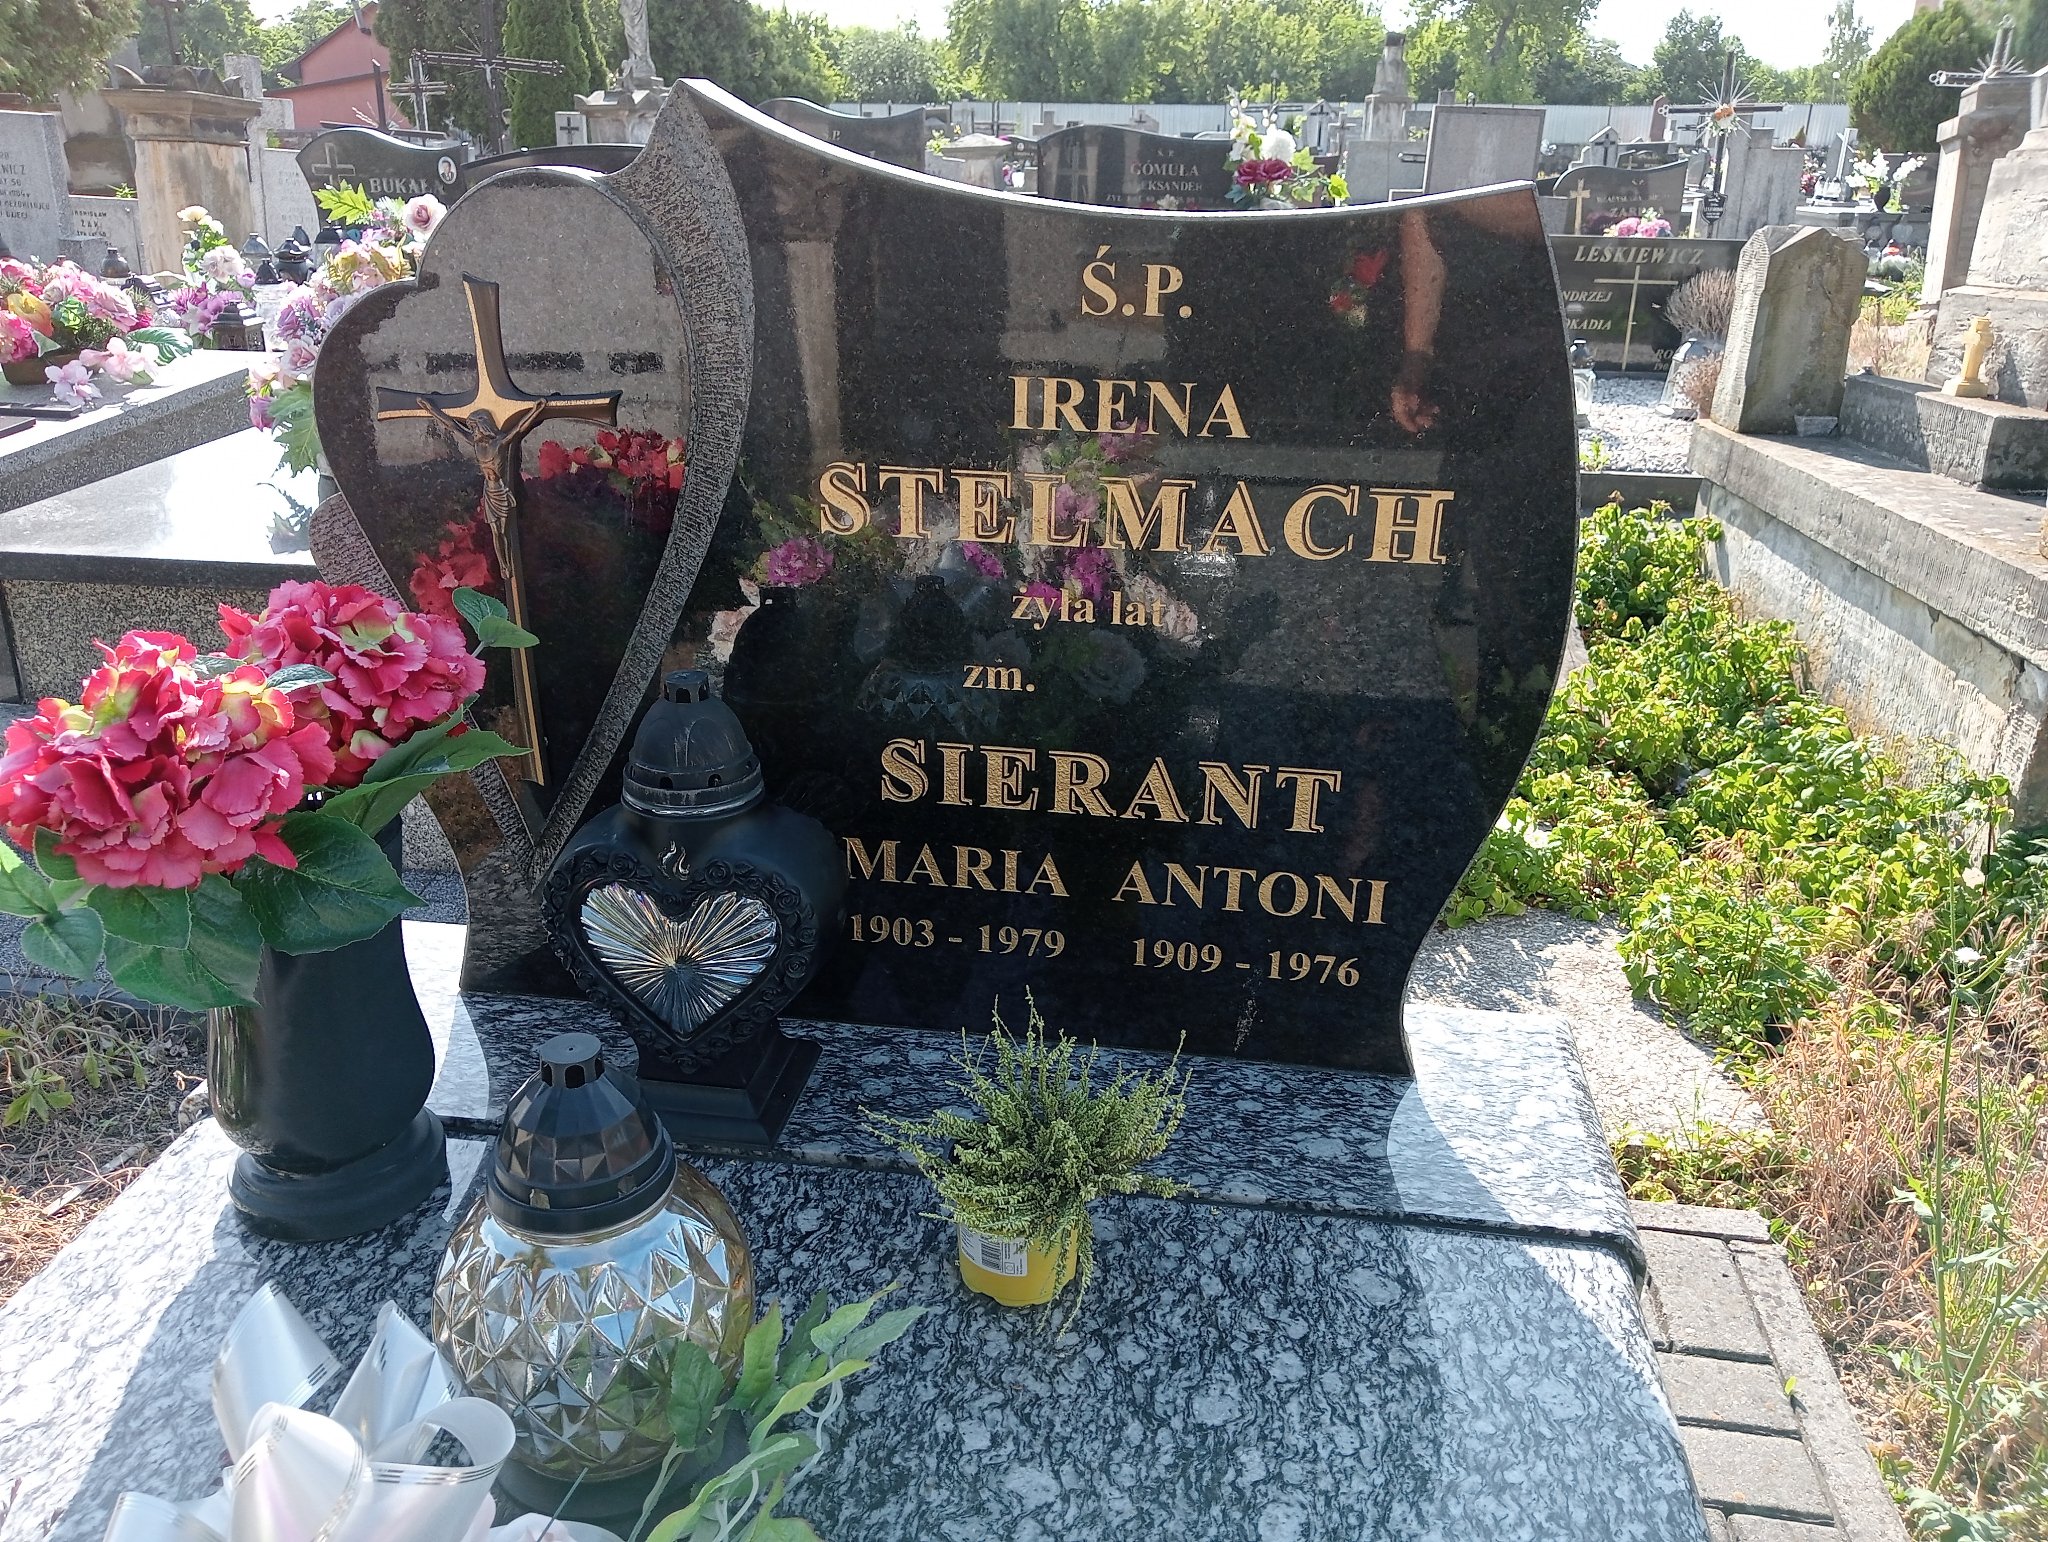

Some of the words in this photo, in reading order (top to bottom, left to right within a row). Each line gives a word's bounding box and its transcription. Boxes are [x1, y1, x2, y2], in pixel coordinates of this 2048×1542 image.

[1081, 243, 1194, 319] Ś.P.
[1573, 244, 1704, 265] LEŚKIEWICZ
[1561, 290, 1613, 303] NDRZEJ
[1009, 374, 1252, 440] IRENA
[818, 459, 1457, 567] STELMACH
[1011, 585, 1096, 630] żyła
[1109, 586, 1167, 628] lat
[963, 663, 1036, 692] zm.
[880, 737, 1343, 834] SIERANT
[844, 836, 1072, 898] MARIA
[1112, 858, 1389, 926] ANTONI
[850, 913, 935, 950] 1903
[978, 923, 1067, 960] 1979
[1133, 937, 1224, 974] 1909
[1266, 949, 1361, 988] 1976
